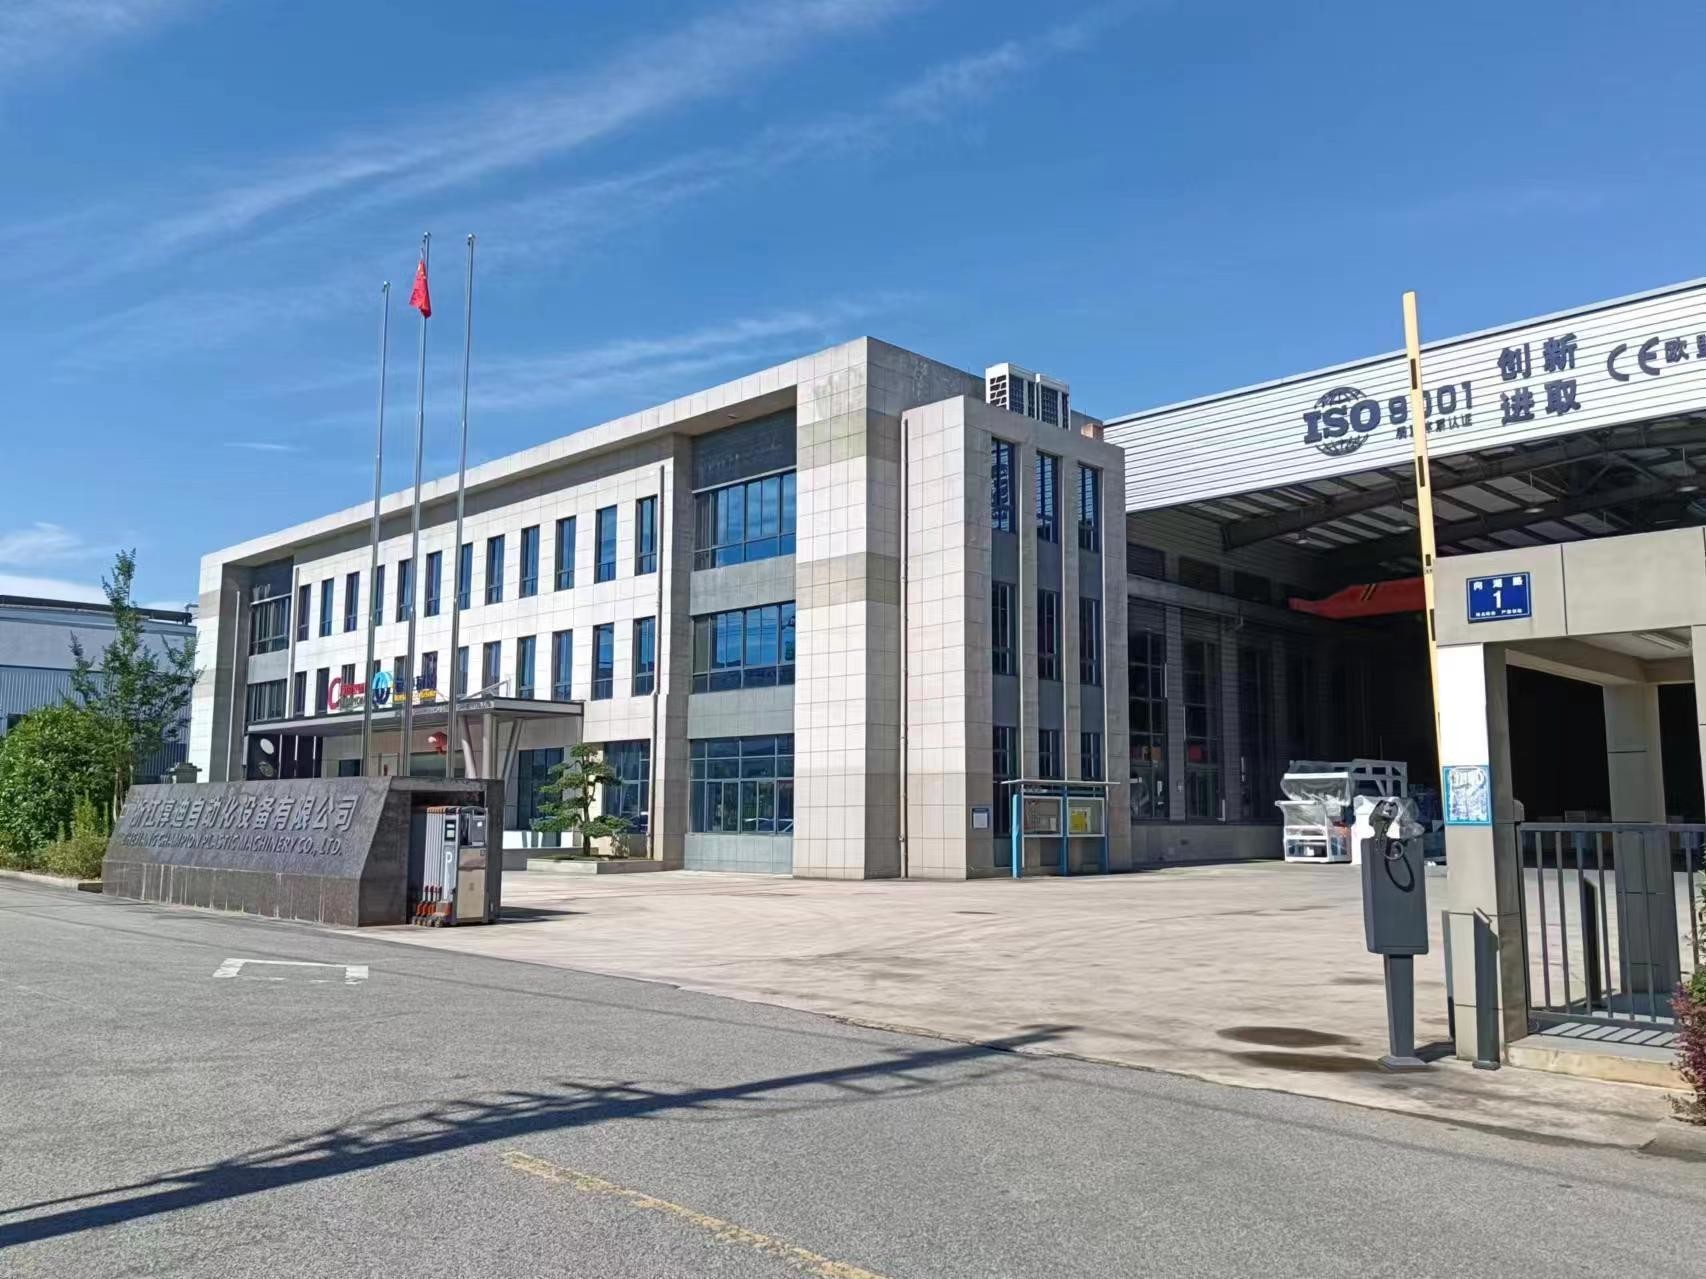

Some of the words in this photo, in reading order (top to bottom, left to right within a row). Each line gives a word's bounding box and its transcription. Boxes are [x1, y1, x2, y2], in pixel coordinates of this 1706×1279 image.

[1497, 332, 1577, 381] 创新
[1607, 336, 1660, 382] CE
[1303, 400, 1381, 444] ISO
[1500, 379, 1581, 426] 进取
[1396, 413, 1473, 440] 质体系认证
[1493, 590, 1502, 609] 1
[158, 832, 202, 849] CHAMPION
[202, 834, 240, 850] PLASTIC
[240, 834, 298, 854] MACHINERY
[319, 838, 343, 857] LTD.
